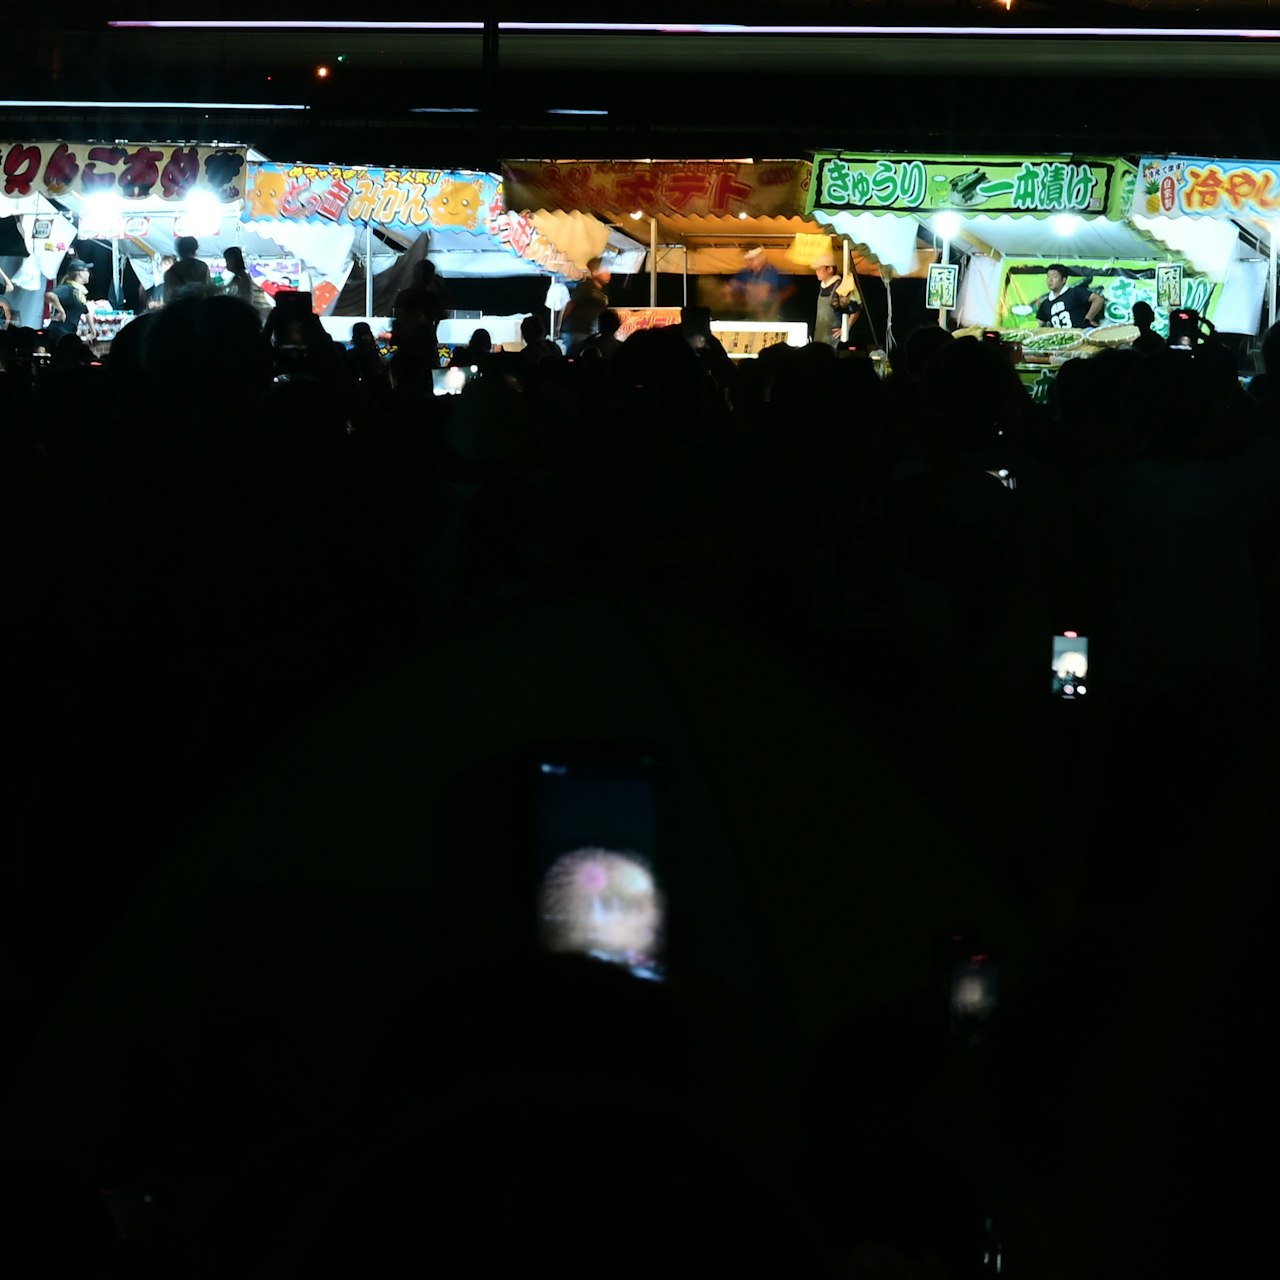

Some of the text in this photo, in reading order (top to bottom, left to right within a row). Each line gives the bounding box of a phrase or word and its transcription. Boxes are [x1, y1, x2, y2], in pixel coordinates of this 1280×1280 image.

[385, 169, 440, 185] 大人気!
[824, 159, 927, 208] きゅうり
[976, 162, 1097, 210] 一本漬け
